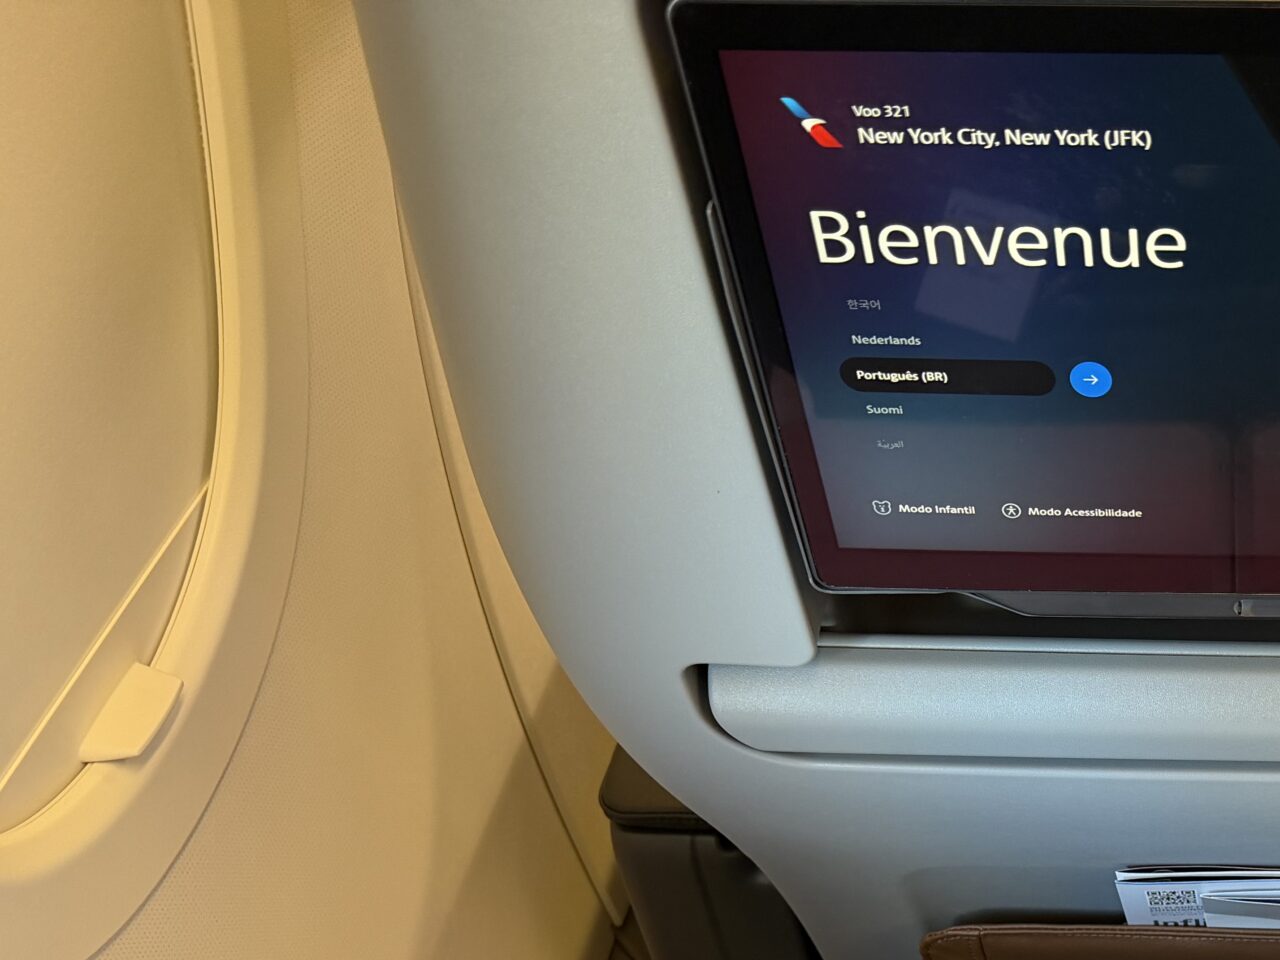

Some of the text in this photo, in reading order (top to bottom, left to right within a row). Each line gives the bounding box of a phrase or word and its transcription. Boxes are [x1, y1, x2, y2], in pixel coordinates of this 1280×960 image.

[851, 105, 910, 118] Voo 321
[857, 127, 1152, 150] New York City, New York (JFK)
[809, 210, 1187, 268] Bienvenue
[847, 299, 881, 310] 한국어
[851, 335, 921, 346] Nederlands
[856, 370, 949, 384] Português (BR)
[866, 404, 904, 415] Suomi
[898, 504, 976, 515] Modo Infantil
[1028, 507, 1143, 518] Modo Acessibilidade
